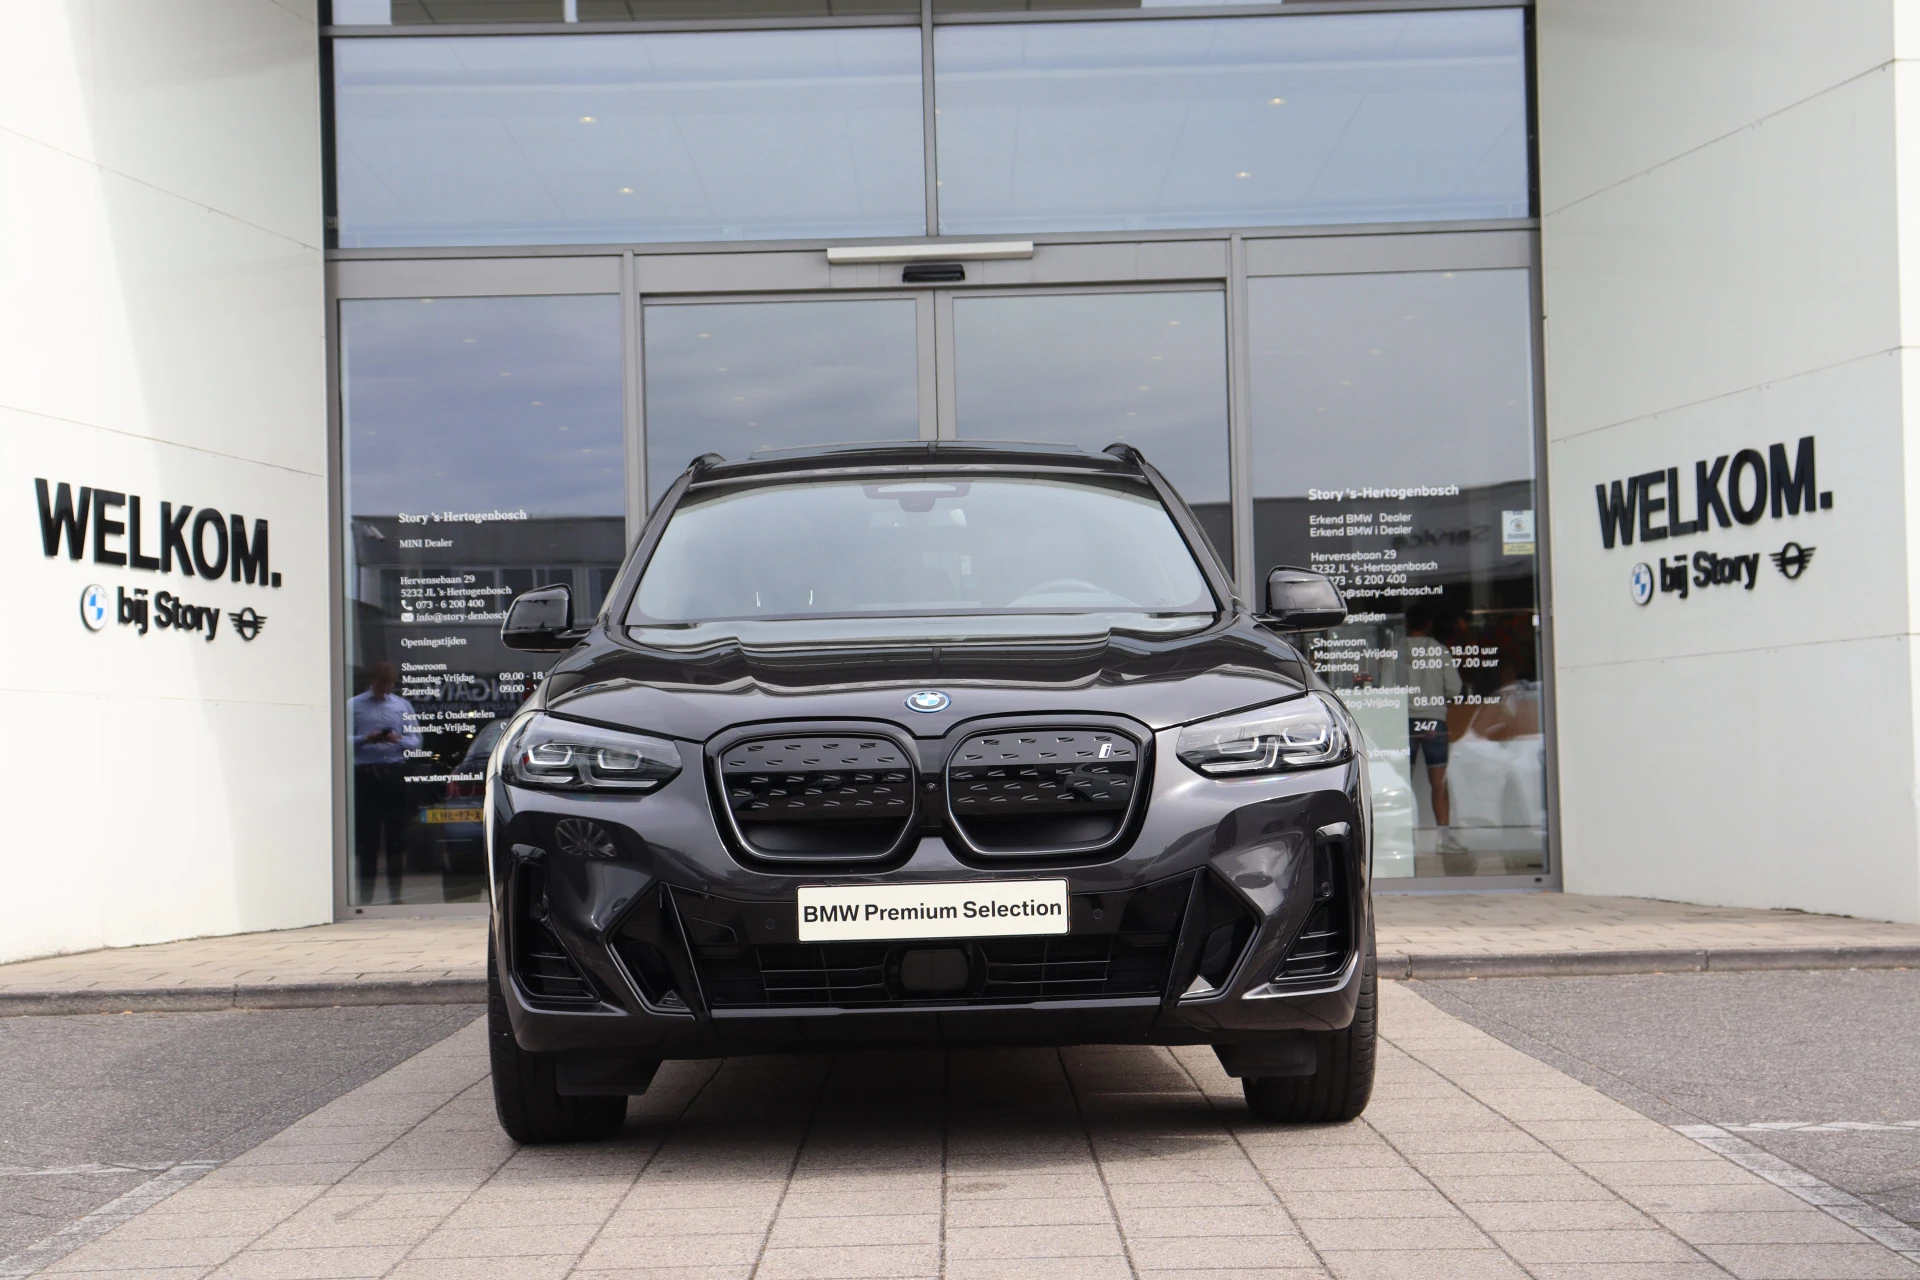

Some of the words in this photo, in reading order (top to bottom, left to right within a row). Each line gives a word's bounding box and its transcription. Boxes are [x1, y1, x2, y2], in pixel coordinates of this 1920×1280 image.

[1308, 488, 1343, 501] Story
[1596, 436, 1833, 549] WELKOM.
[399, 512, 428, 525] Story
[1310, 514, 1344, 525] Erkend
[1346, 513, 1373, 524] BMW
[1379, 512, 1412, 523] Dealer
[34, 477, 282, 588] WELKOM.
[1310, 527, 1344, 537] Erkend
[1347, 526, 1373, 536] BMW
[1380, 525, 1412, 535] Dealer
[399, 539, 423, 549] MINI
[425, 538, 453, 548] Dealer
[1311, 550, 1382, 561] Hervensebaan
[1383, 549, 1397, 560] 29
[1311, 563, 1336, 574] 5232
[1338, 563, 1349, 574] JL
[400, 575, 462, 585] Hervensebaan
[463, 574, 475, 584] 29
[1355, 575, 1362, 585] 6
[1364, 574, 1385, 585] 200
[1386, 573, 1407, 584] 400
[1660, 555, 1688, 599] bij
[1693, 551, 1760, 590] Story
[400, 588, 423, 598] 5232
[424, 588, 436, 598] JL
[1340, 585, 1443, 599] o@story-denbosch.nl
[415, 600, 433, 609] 073
[440, 600, 447, 609] 6
[448, 599, 465, 608] 200
[466, 599, 485, 608] 400
[117, 586, 148, 635] bij
[154, 591, 220, 641] Story
[416, 610, 508, 623] info@story-denbosch
[1346, 611, 1386, 624] gstijden
[401, 636, 467, 648] Openingstijden
[1313, 638, 1366, 648] Showroom
[1314, 649, 1398, 661] Maandag-Vrijdag
[1412, 647, 1442, 657] 09.00
[1451, 646, 1479, 656] 18.00
[1481, 647, 1498, 655] uur
[401, 662, 447, 672] Showroom
[1314, 663, 1359, 673] Zaterdag
[1412, 659, 1443, 669] 09.00
[1483, 659, 1499, 667] uur
[402, 674, 475, 685] Maandag-Vrijdag
[499, 672, 525, 681] 09.00
[402, 687, 440, 698] Zaterdag
[499, 684, 525, 693] 09.00
[1364, 685, 1421, 696] Onderdelen
[1414, 696, 1445, 707] 08.00
[1483, 696, 1500, 704] uur
[403, 711, 435, 721] Service
[436, 711, 443, 720] &
[403, 723, 476, 734] Maandag-Vrijdag
[1414, 721, 1437, 732] 24/7
[403, 749, 432, 758] Online
[404, 772, 483, 783] www.storymini.nl
[803, 904, 860, 923] BMW
[865, 902, 957, 921] Premium
[963, 899, 1062, 919] Selection
